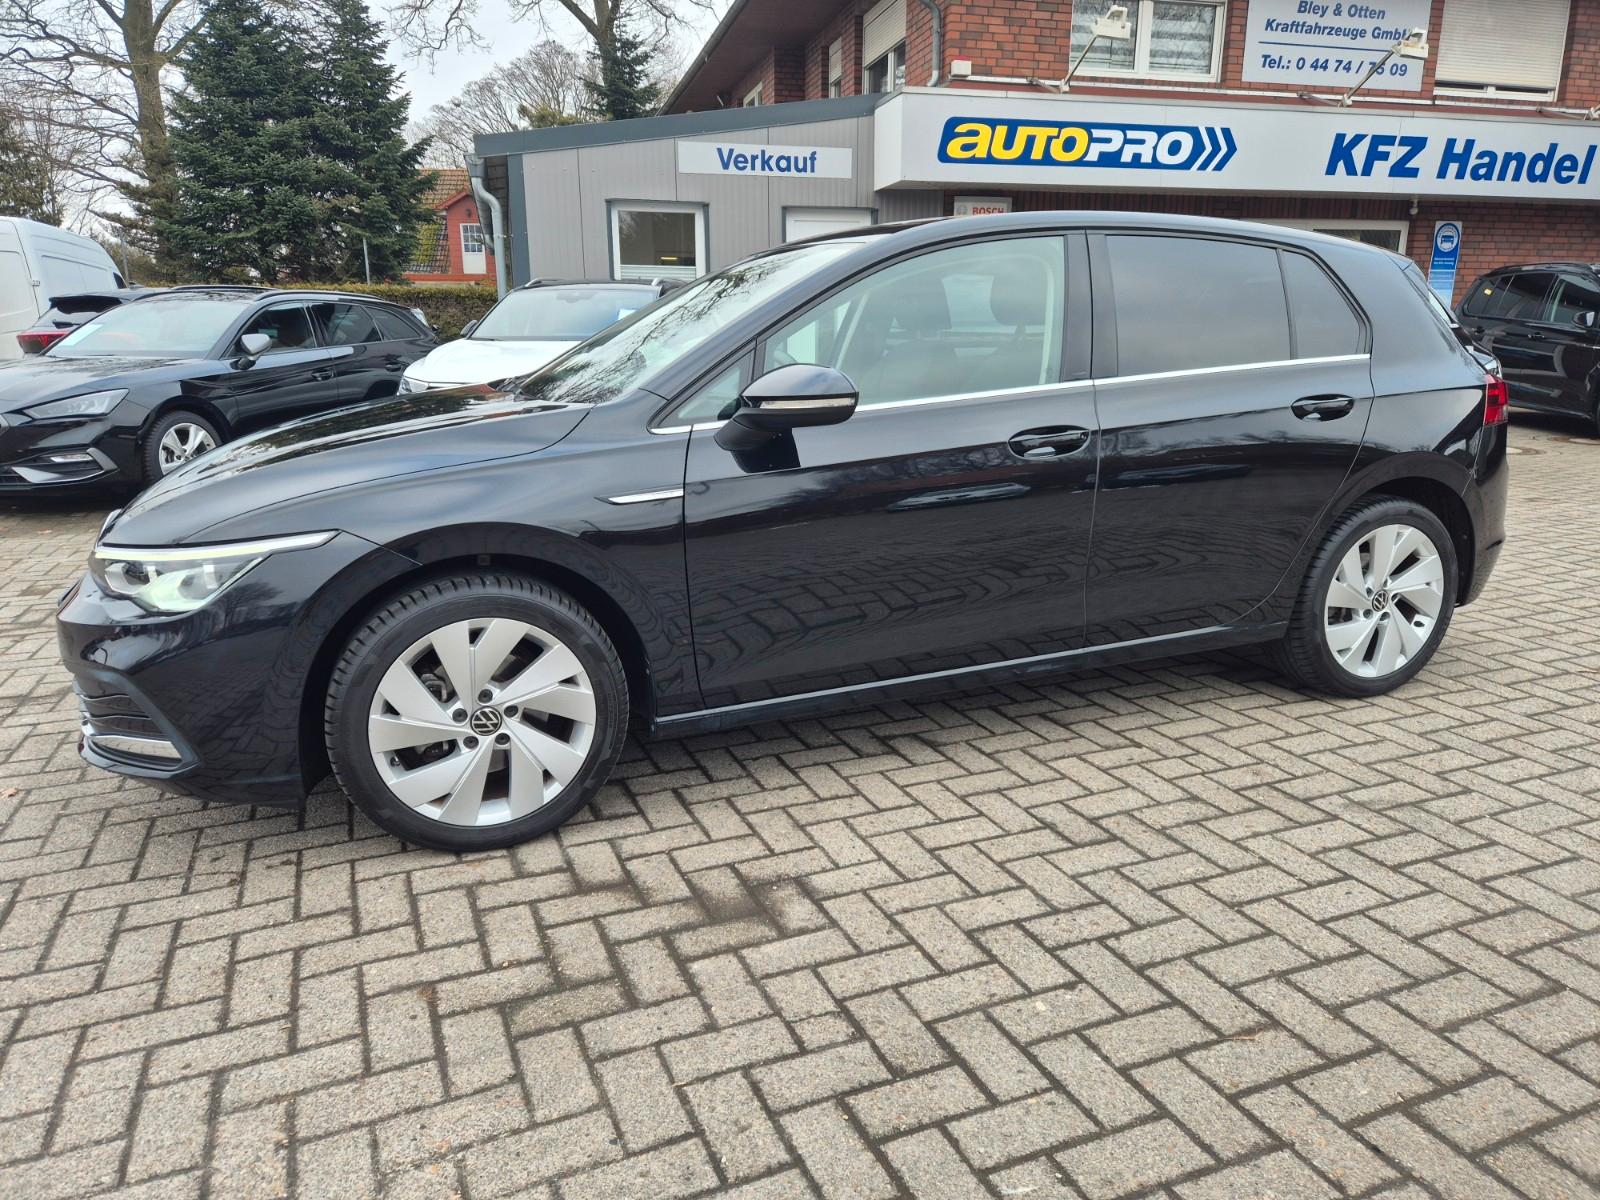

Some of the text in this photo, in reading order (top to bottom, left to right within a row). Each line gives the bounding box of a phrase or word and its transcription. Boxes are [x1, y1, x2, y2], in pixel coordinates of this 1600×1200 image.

[1297, 1, 1385, 19] Bley & Otten
[1265, 19, 1366, 38] Kraftfahrzeuge
[1261, 54, 1291, 69] Tel.:
[1296, 57, 1305, 70] 0
[1310, 59, 1329, 72] 44
[1334, 60, 1352, 73] 74
[1356, 61, 1364, 74] /
[1390, 63, 1408, 77] 09
[716, 148, 816, 173] Verkauf
[1325, 133, 1597, 184] KFZ Handel
